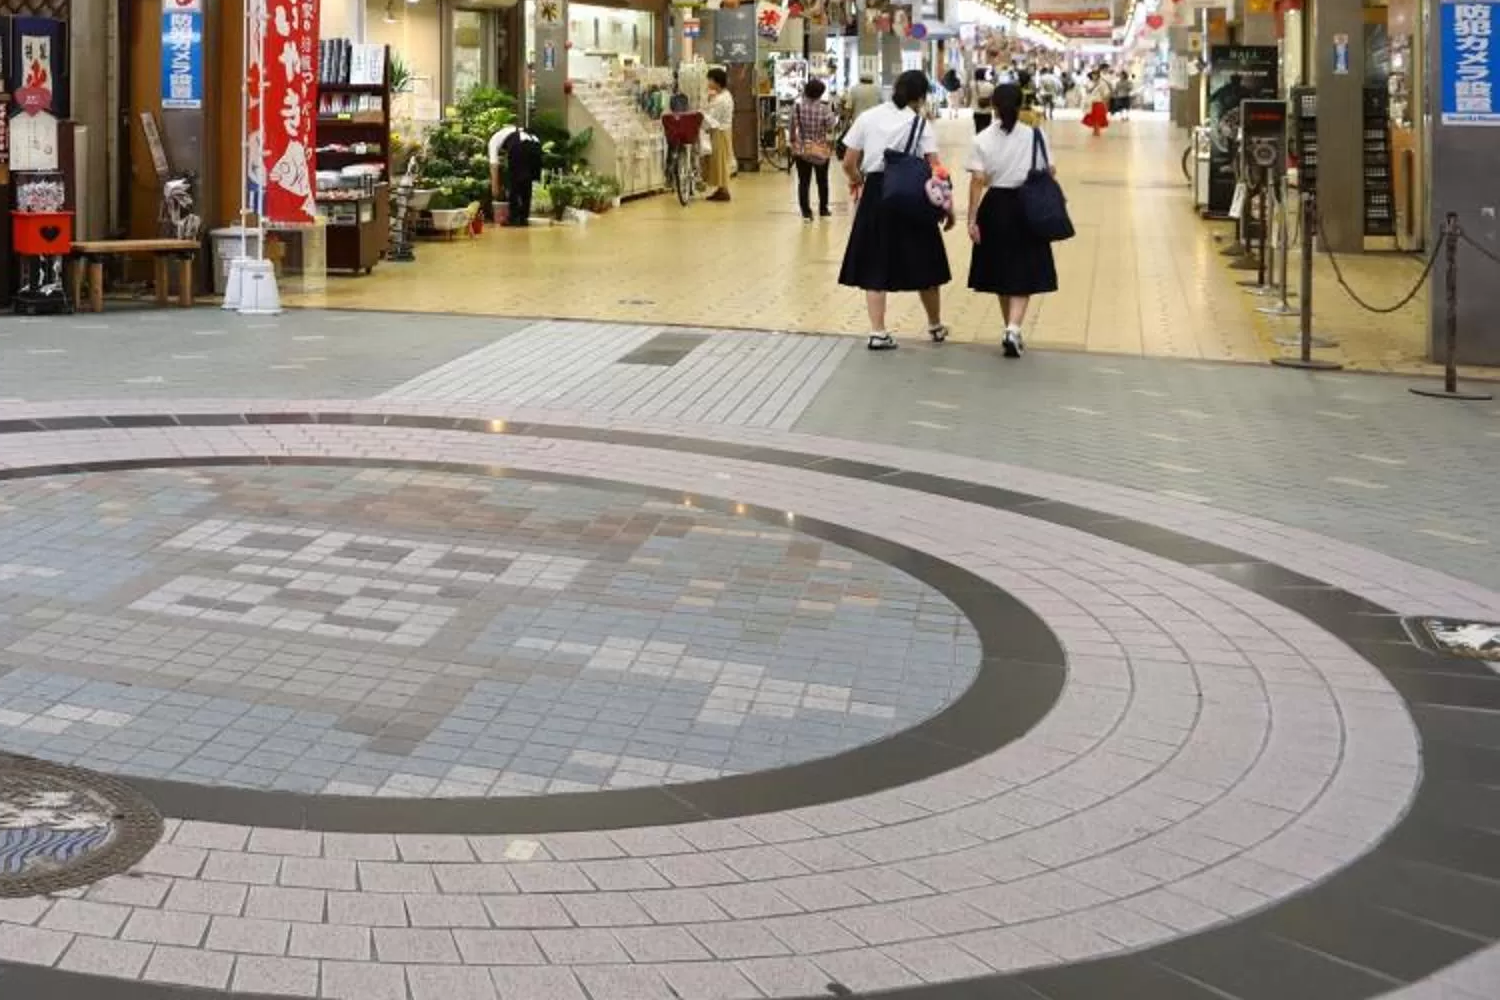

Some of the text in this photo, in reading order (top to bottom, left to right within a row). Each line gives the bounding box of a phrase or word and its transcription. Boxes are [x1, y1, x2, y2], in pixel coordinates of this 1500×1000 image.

[1453, 3, 1493, 114] 防犯カメラ設置
